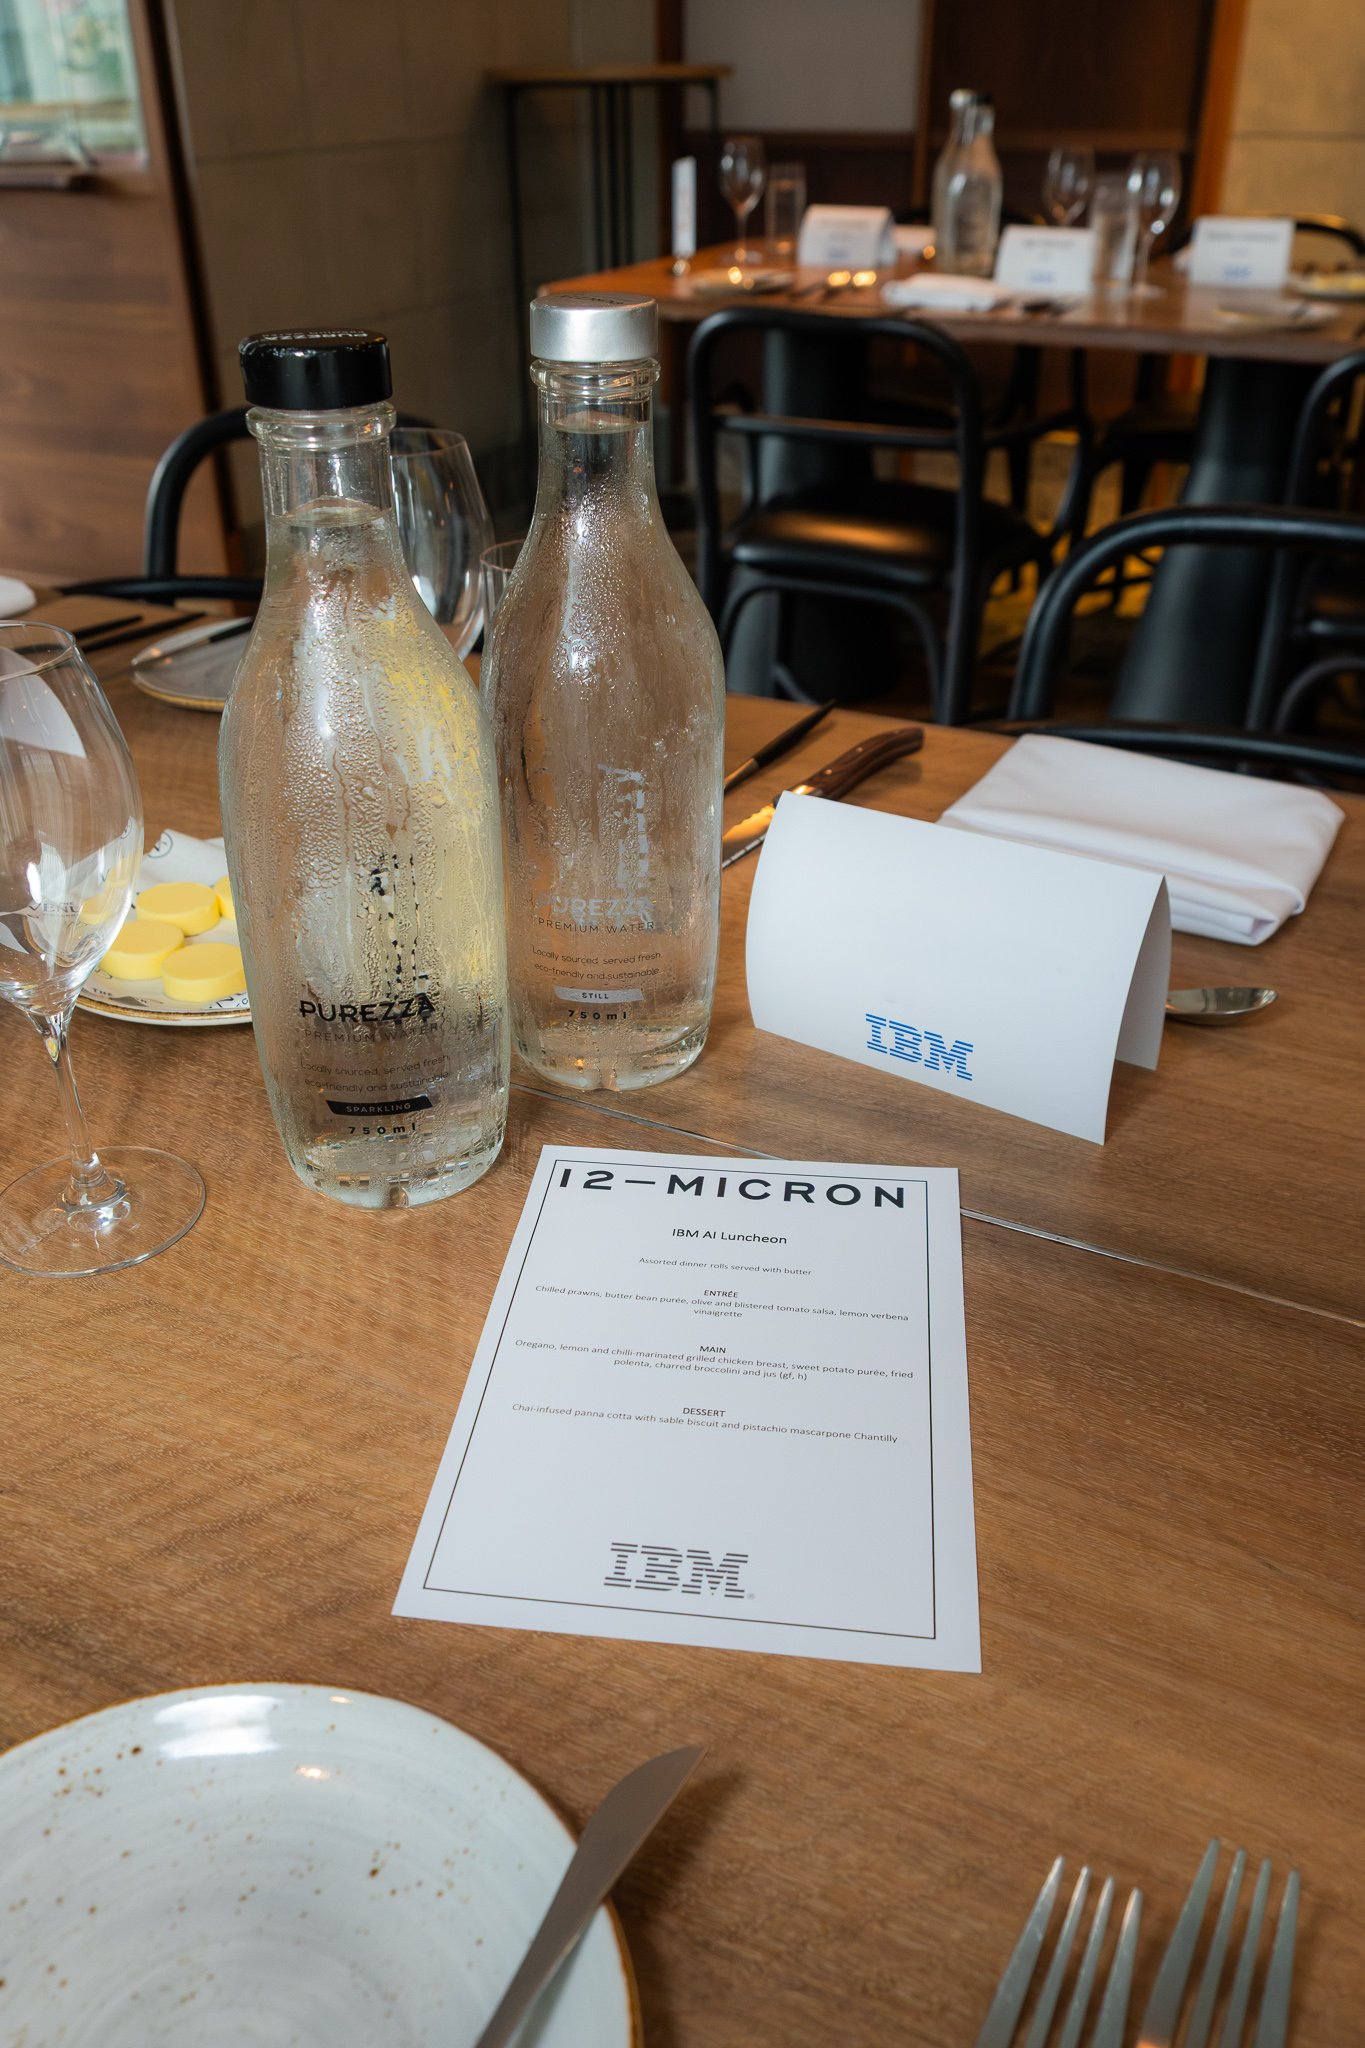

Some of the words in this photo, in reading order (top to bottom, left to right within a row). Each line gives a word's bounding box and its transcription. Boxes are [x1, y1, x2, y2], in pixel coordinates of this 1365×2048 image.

[538, 918, 599, 933] PREMIUM
[606, 921, 654, 934] WATER
[532, 945, 559, 961] Locally
[603, 955, 636, 965] served
[586, 972, 605, 980] and
[300, 992, 435, 1022] PUREZZA
[305, 1029, 375, 1042] PREMIUM
[385, 1023, 438, 1040] WATER
[866, 1013, 974, 1081] IBM
[301, 1060, 331, 1075] Locally
[384, 1062, 420, 1075] served
[304, 1078, 364, 1093] eco-friendly
[366, 1083, 388, 1092] and
[345, 1102, 412, 1113] SPARKLING
[672, 1228, 700, 1238] IBM
[702, 1230, 717, 1239] AI
[720, 1231, 787, 1245] Luncheon
[639, 1257, 678, 1266] Assorted
[679, 1260, 707, 1268] dinner
[784, 1267, 812, 1275] butter
[703, 1289, 739, 1299] ENTRÉE
[535, 1285, 566, 1294] Chilled
[567, 1289, 602, 1298] prawns,
[605, 1291, 633, 1300] butter
[659, 1297, 689, 1305] purée,
[691, 1298, 713, 1306] olive
[734, 1301, 774, 1311] blistered
[776, 1305, 810, 1313] tomato
[812, 1308, 837, 1316] salsa,
[839, 1309, 869, 1318] lemon
[870, 1312, 909, 1321] verbena
[693, 1308, 743, 1318] vinaigrette
[699, 1345, 727, 1354] MAIN
[515, 1339, 557, 1351] Oregano,
[559, 1343, 589, 1352] lemon
[591, 1347, 610, 1355] and
[611, 1348, 684, 1361] chilli-marinated
[685, 1354, 716, 1364] grilled
[718, 1356, 756, 1366] chicken
[756, 1359, 789, 1370] breast,
[791, 1363, 820, 1372] sweet
[822, 1366, 855, 1375] potato
[857, 1369, 888, 1378] purée,
[890, 1369, 914, 1379] fried
[613, 1359, 652, 1369] polenta,
[654, 1361, 692, 1371] charred
[694, 1364, 741, 1375] broccolini
[742, 1369, 761, 1377] and
[763, 1370, 777, 1378] jus
[779, 1371, 795, 1380] (gf,
[796, 1372, 808, 1381] h)
[682, 1407, 726, 1418] DESSERT
[512, 1404, 573, 1415] Chai-infused
[574, 1410, 605, 1418] panna
[606, 1412, 632, 1420] cotta
[634, 1414, 656, 1422] with
[658, 1416, 685, 1425] sable
[687, 1417, 719, 1428] biscuit
[742, 1424, 788, 1434] pistachio
[790, 1428, 852, 1439] mascarpone
[853, 1432, 898, 1444] Chantilly
[603, 1542, 749, 1599] IBM
